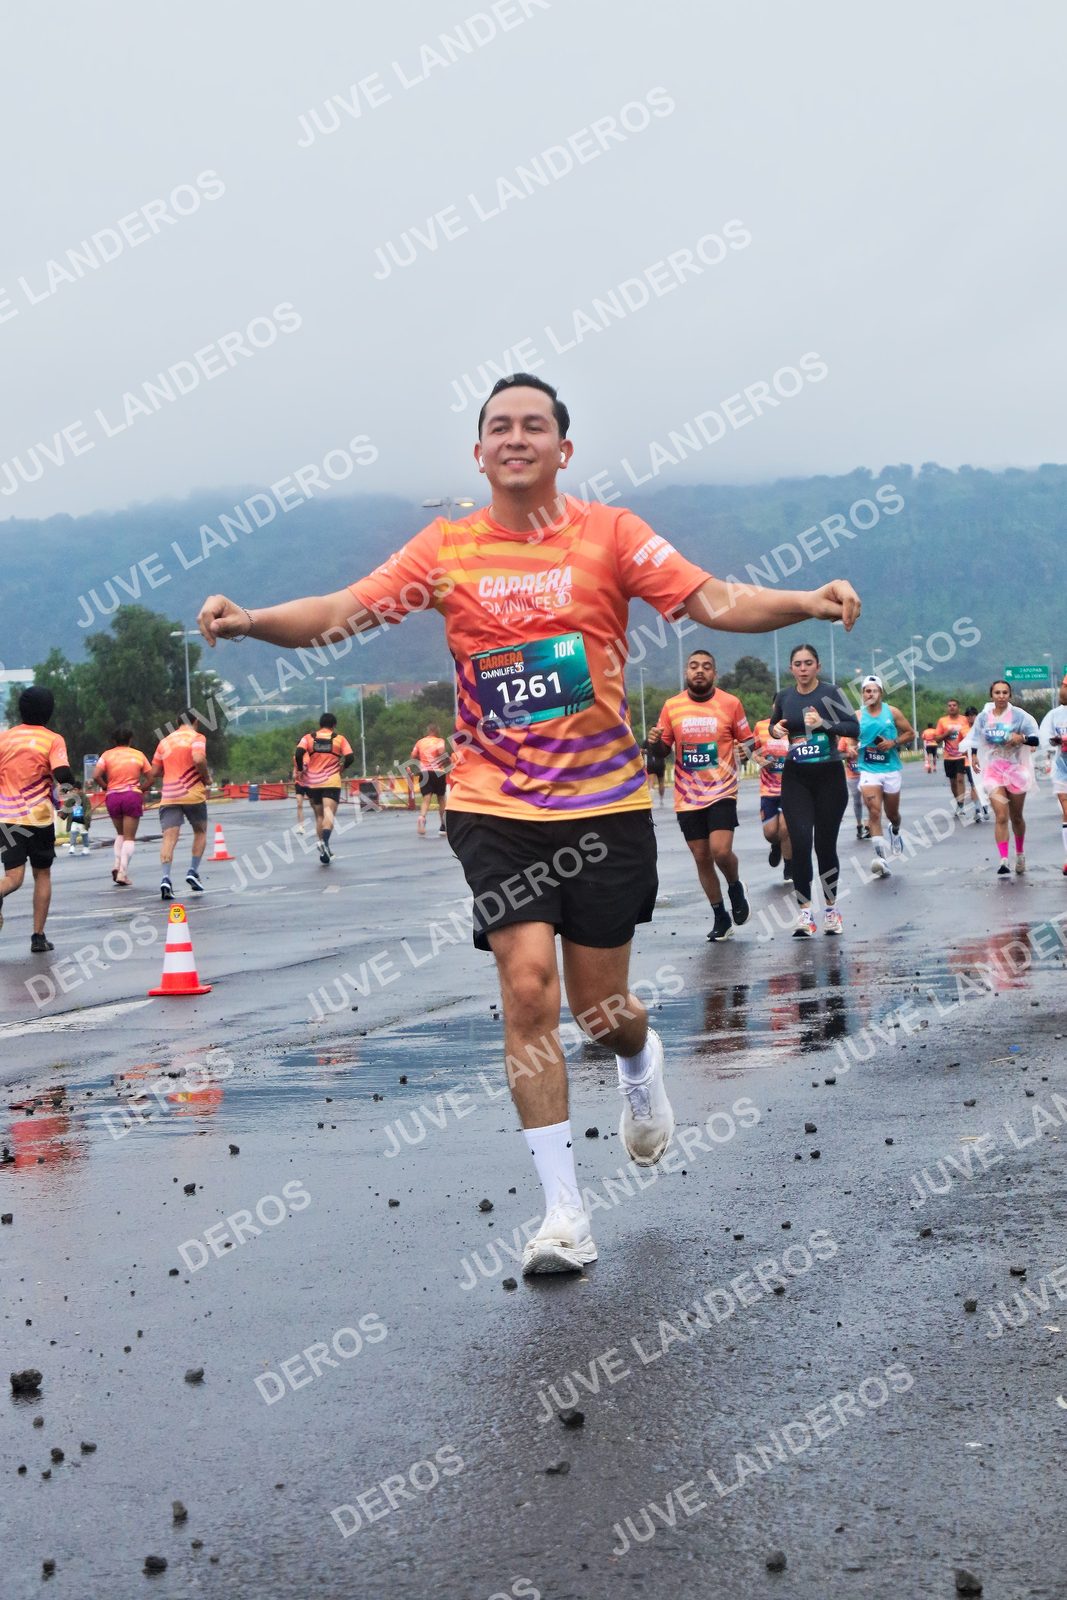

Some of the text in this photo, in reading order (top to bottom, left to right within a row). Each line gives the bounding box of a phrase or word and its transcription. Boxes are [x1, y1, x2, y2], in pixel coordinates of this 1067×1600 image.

[479, 566, 572, 598] CARRERA
[553, 640, 575, 659] 10K
[479, 650, 524, 671] CARRERA
[481, 666, 515, 679] OMNILIFE
[496, 671, 562, 704] 1261
[687, 753, 711, 763] 1623
[796, 745, 820, 756] 1622
